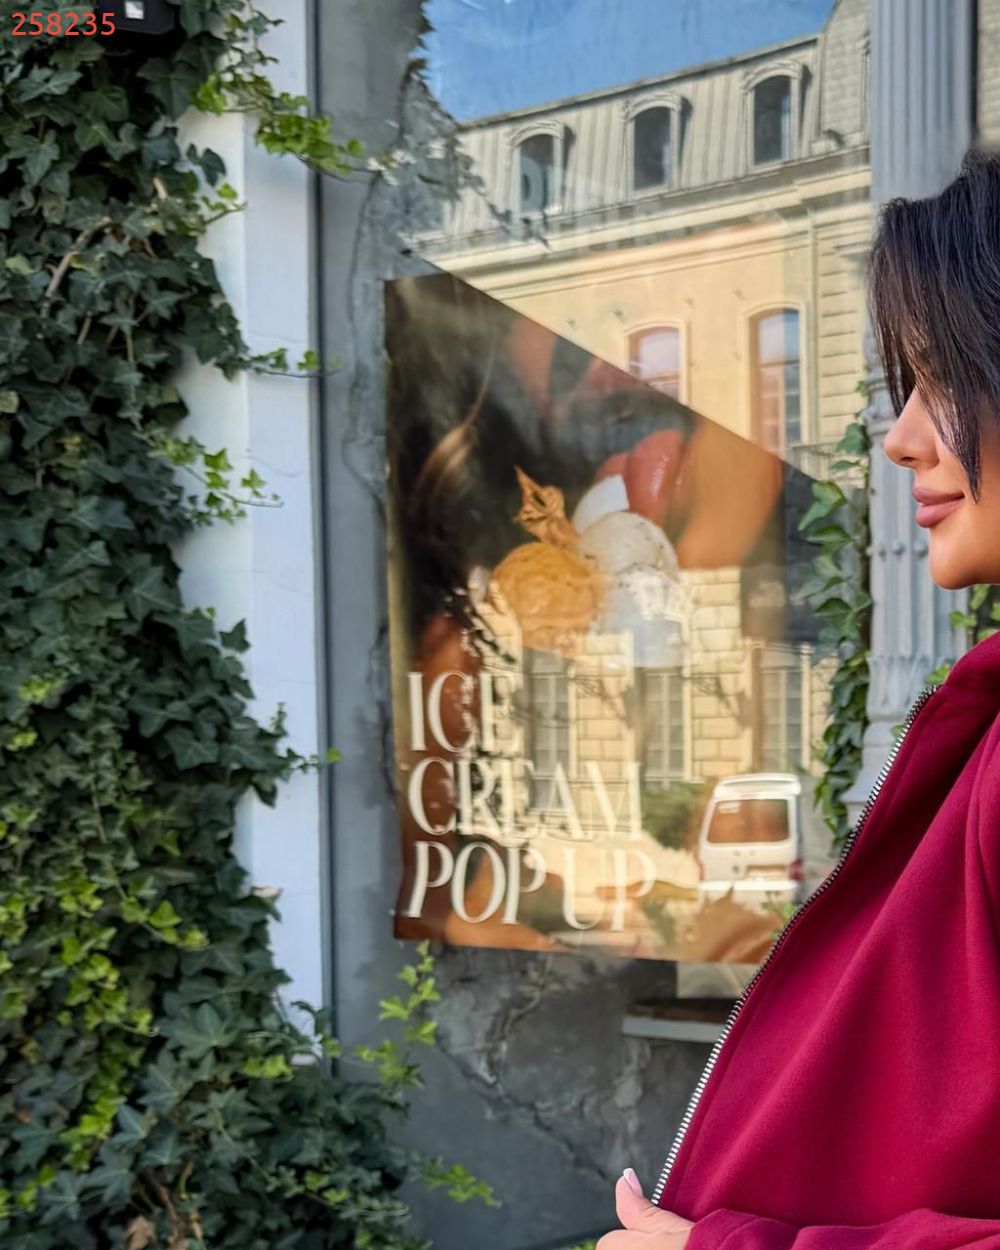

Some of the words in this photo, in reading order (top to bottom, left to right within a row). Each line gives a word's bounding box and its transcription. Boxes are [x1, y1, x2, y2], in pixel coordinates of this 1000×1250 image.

[407, 670, 523, 754] ICE
[408, 757, 642, 841] CREAM
[407, 841, 547, 924] POP
[562, 847, 657, 931] UP
